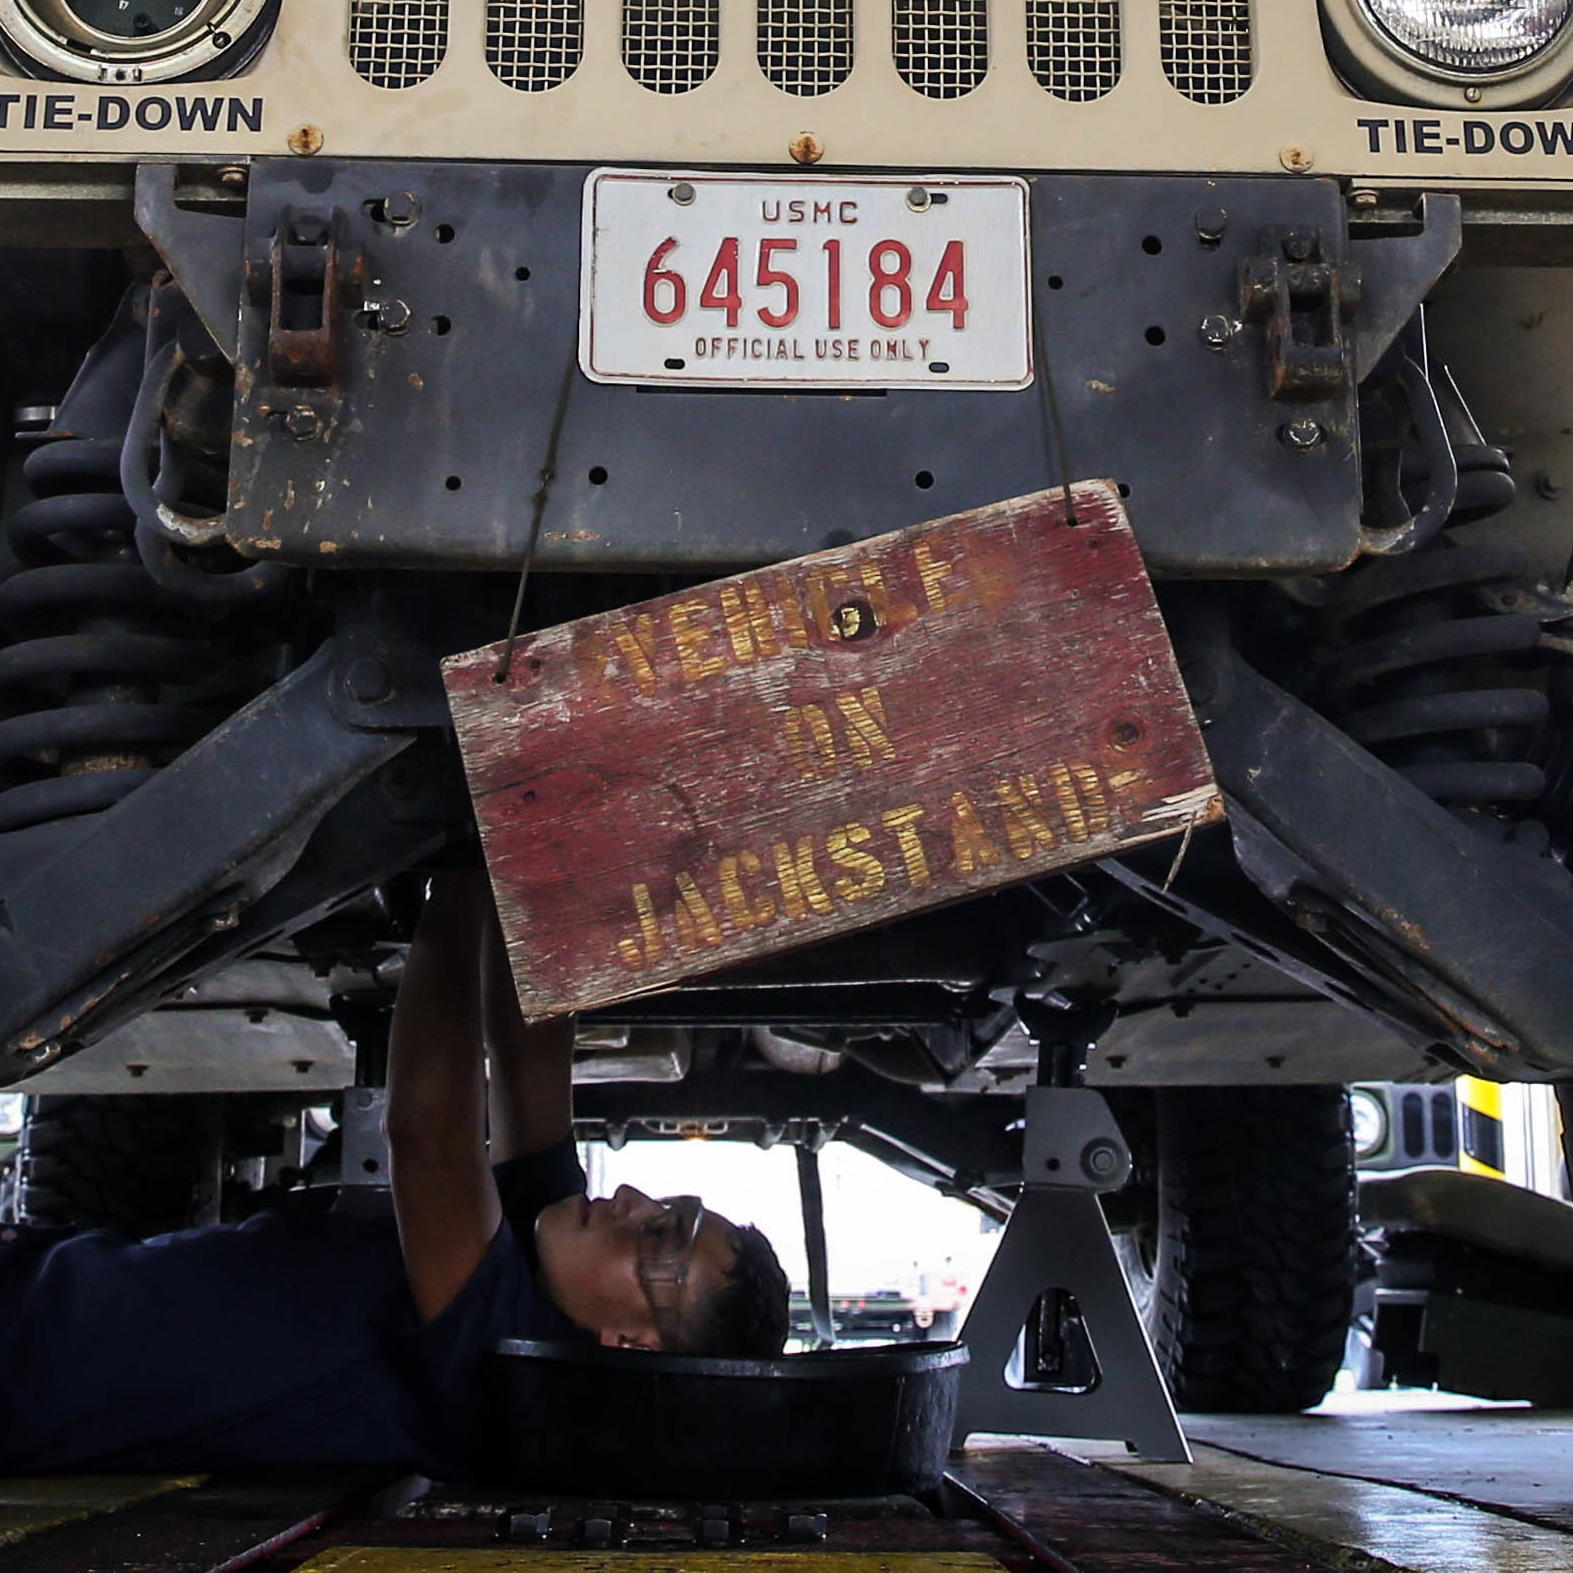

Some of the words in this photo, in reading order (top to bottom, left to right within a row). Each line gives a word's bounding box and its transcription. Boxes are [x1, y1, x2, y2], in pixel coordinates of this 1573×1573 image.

[761, 199, 859, 224] USMC
[642, 236, 970, 330] 645184
[694, 336, 805, 361] OFFICIAL
[814, 338, 859, 362] USE
[870, 339, 932, 362] ONLY
